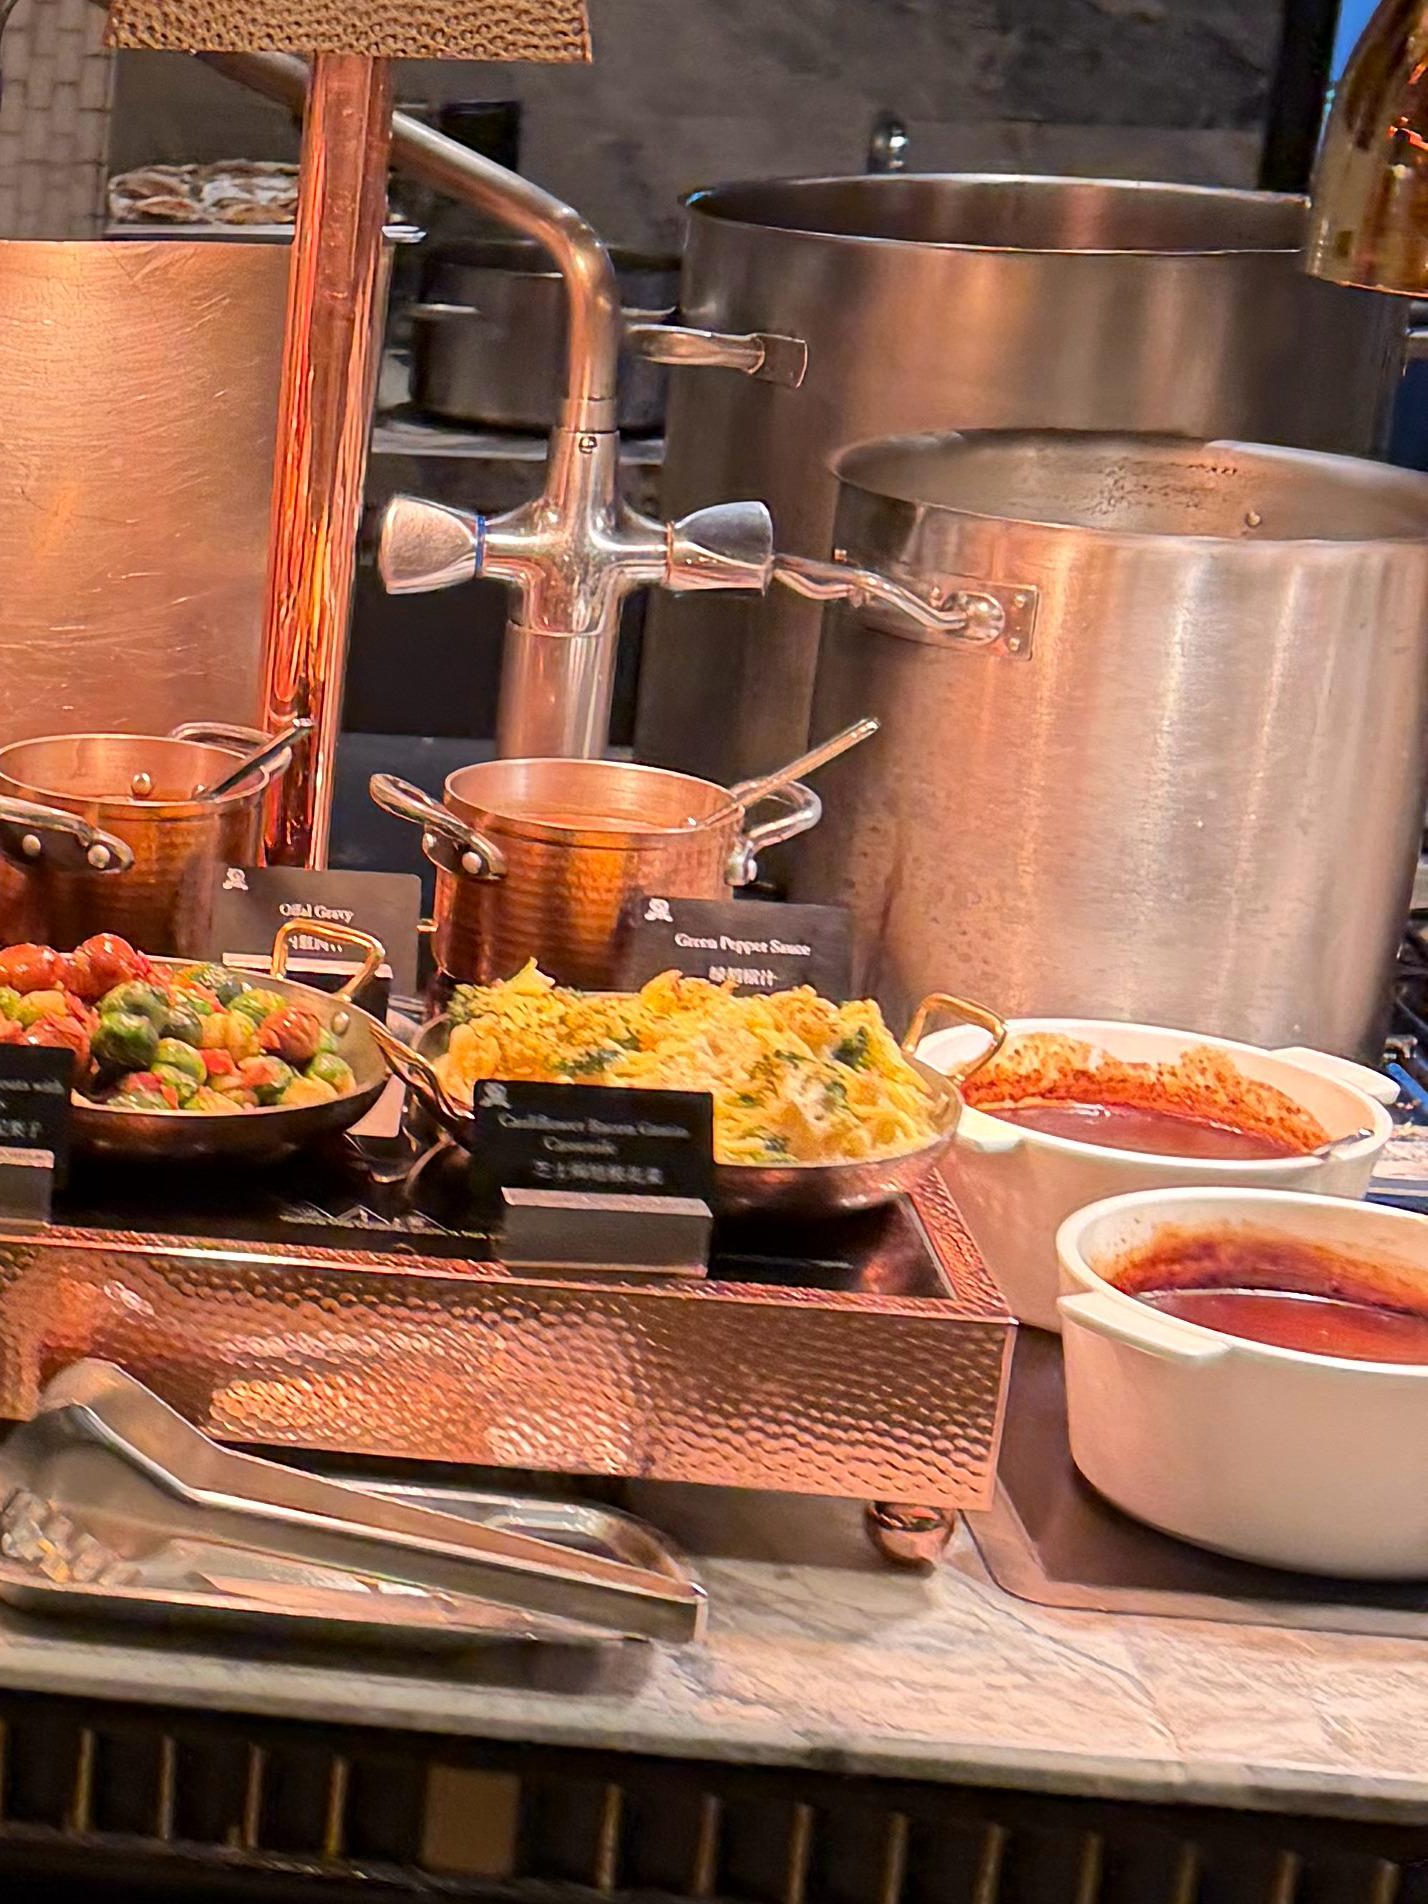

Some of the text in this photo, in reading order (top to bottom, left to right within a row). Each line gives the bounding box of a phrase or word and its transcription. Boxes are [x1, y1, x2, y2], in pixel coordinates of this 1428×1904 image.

[313, 904, 355, 924] Gravy
[674, 932, 812, 957] Green Pepper Sauce
